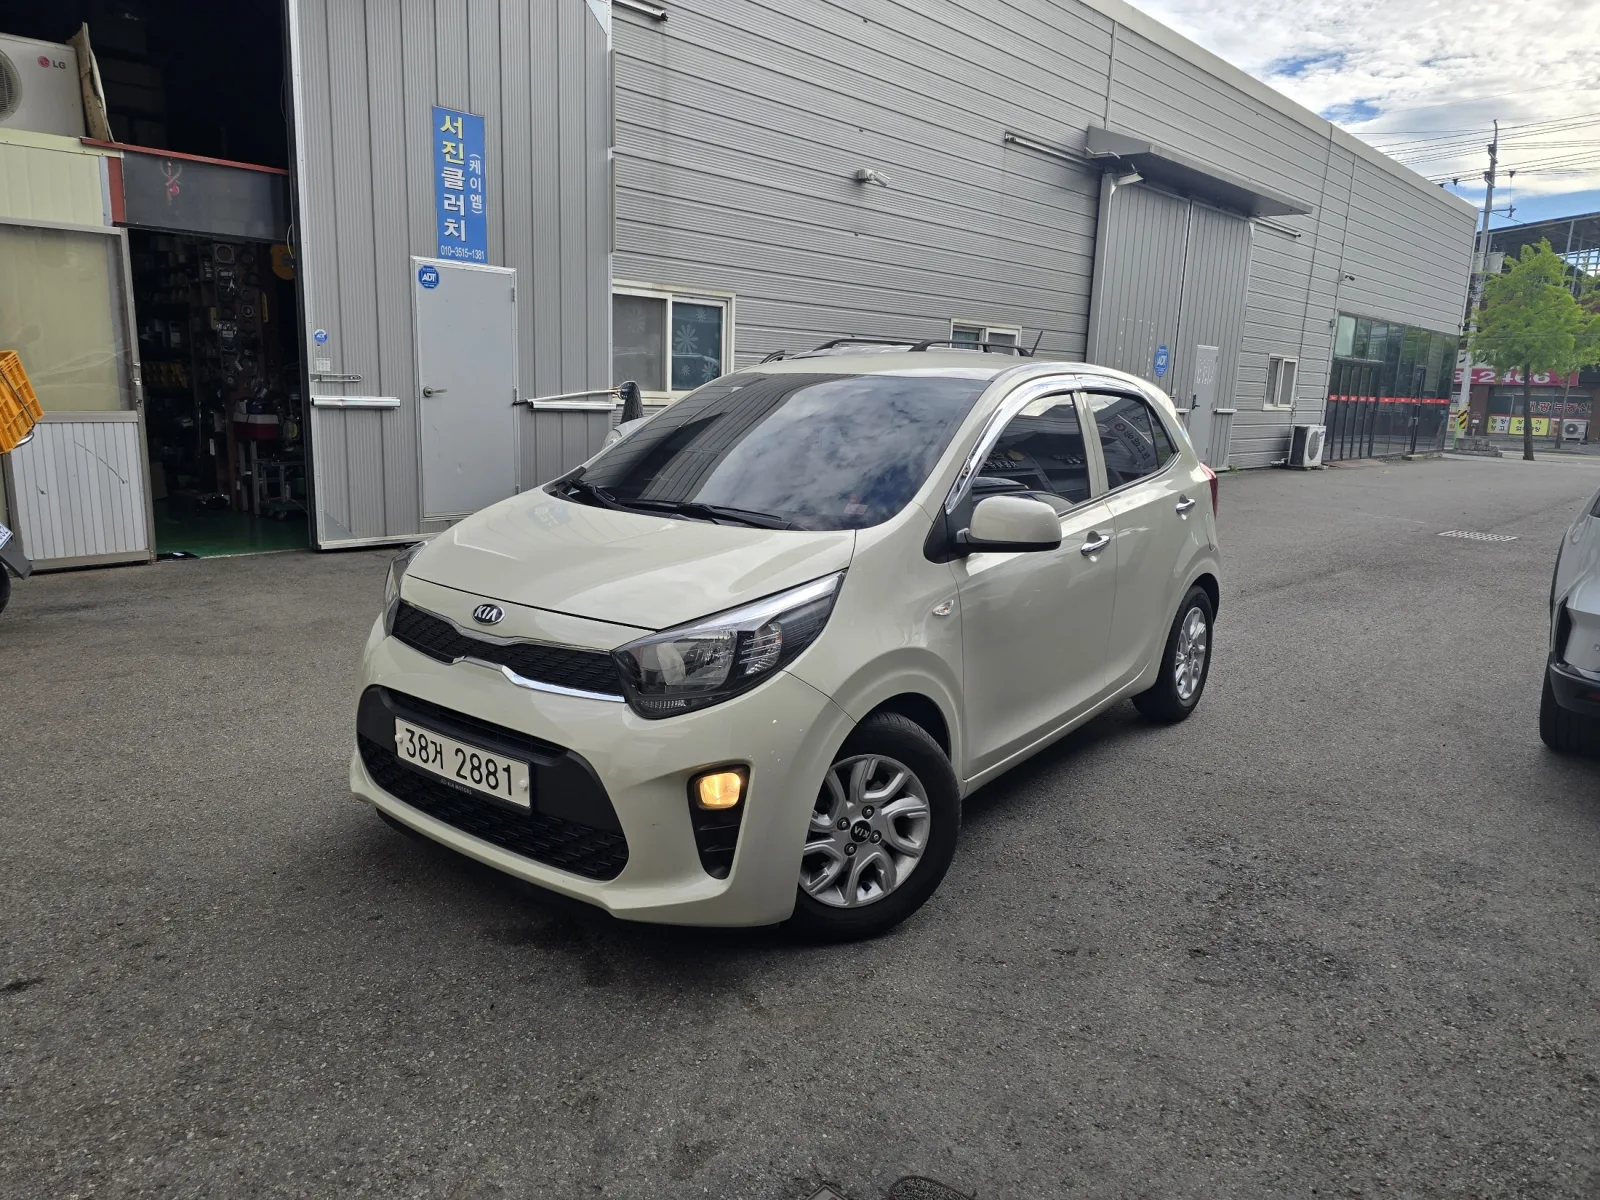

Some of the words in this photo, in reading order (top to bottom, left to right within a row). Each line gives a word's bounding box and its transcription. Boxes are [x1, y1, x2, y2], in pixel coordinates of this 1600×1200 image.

[52, 59, 67, 70] LG
[440, 115, 466, 242] 서진클러치
[468, 153, 483, 214] (케이엠)
[440, 245, 485, 259] 010-3515-1381
[421, 272, 437, 282] ADT
[474, 605, 498, 621] KIA
[405, 727, 444, 770] 38거
[454, 747, 512, 796] 2881
[854, 826, 870, 838] KIA
